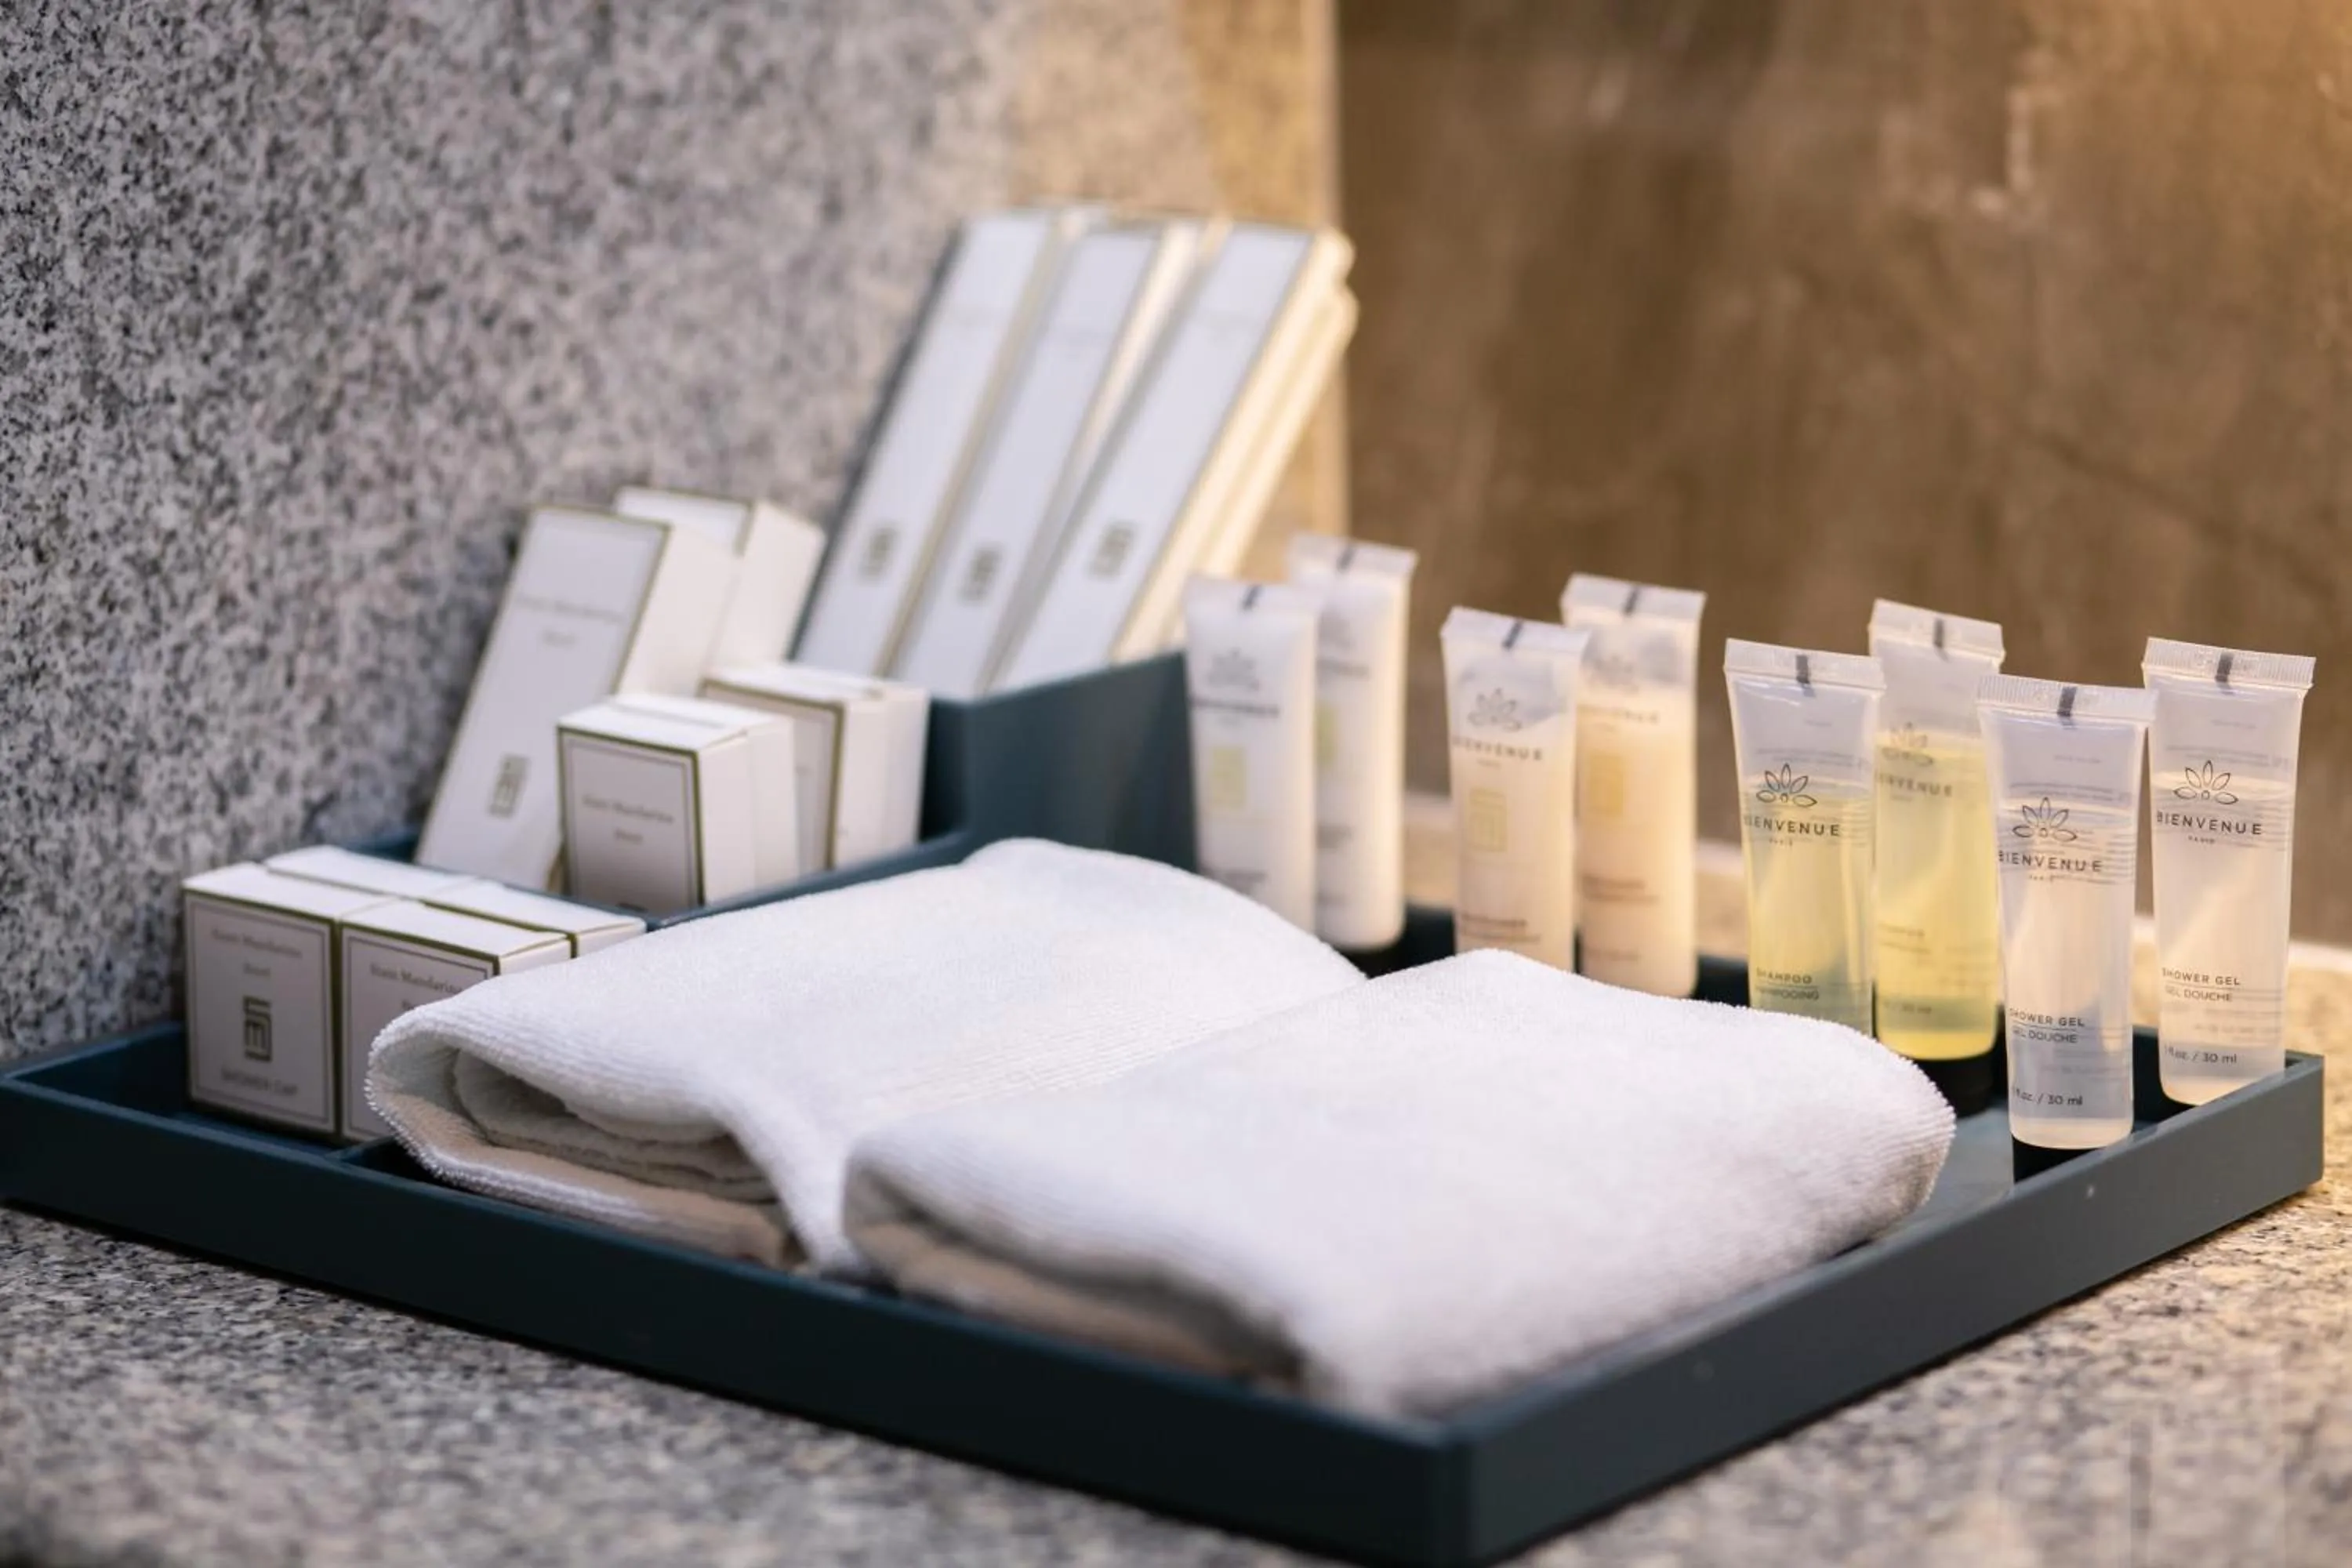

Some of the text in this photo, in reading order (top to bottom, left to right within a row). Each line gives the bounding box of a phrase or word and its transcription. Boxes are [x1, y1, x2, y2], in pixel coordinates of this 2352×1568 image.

[2156, 810, 2262, 835] BIENVENUE
[1998, 850, 2103, 873] BIENVENUE
[2215, 975, 2240, 985] GEL
[2183, 989, 2233, 1002] DOUCHE
[2058, 1017, 2085, 1027] GEL
[2028, 1029, 2078, 1044] DOUCHE
[2203, 1053, 2219, 1064] 30
[2222, 1053, 2238, 1064] ml
[2047, 1094, 2063, 1105] 30
[2067, 1095, 2083, 1106] ml
